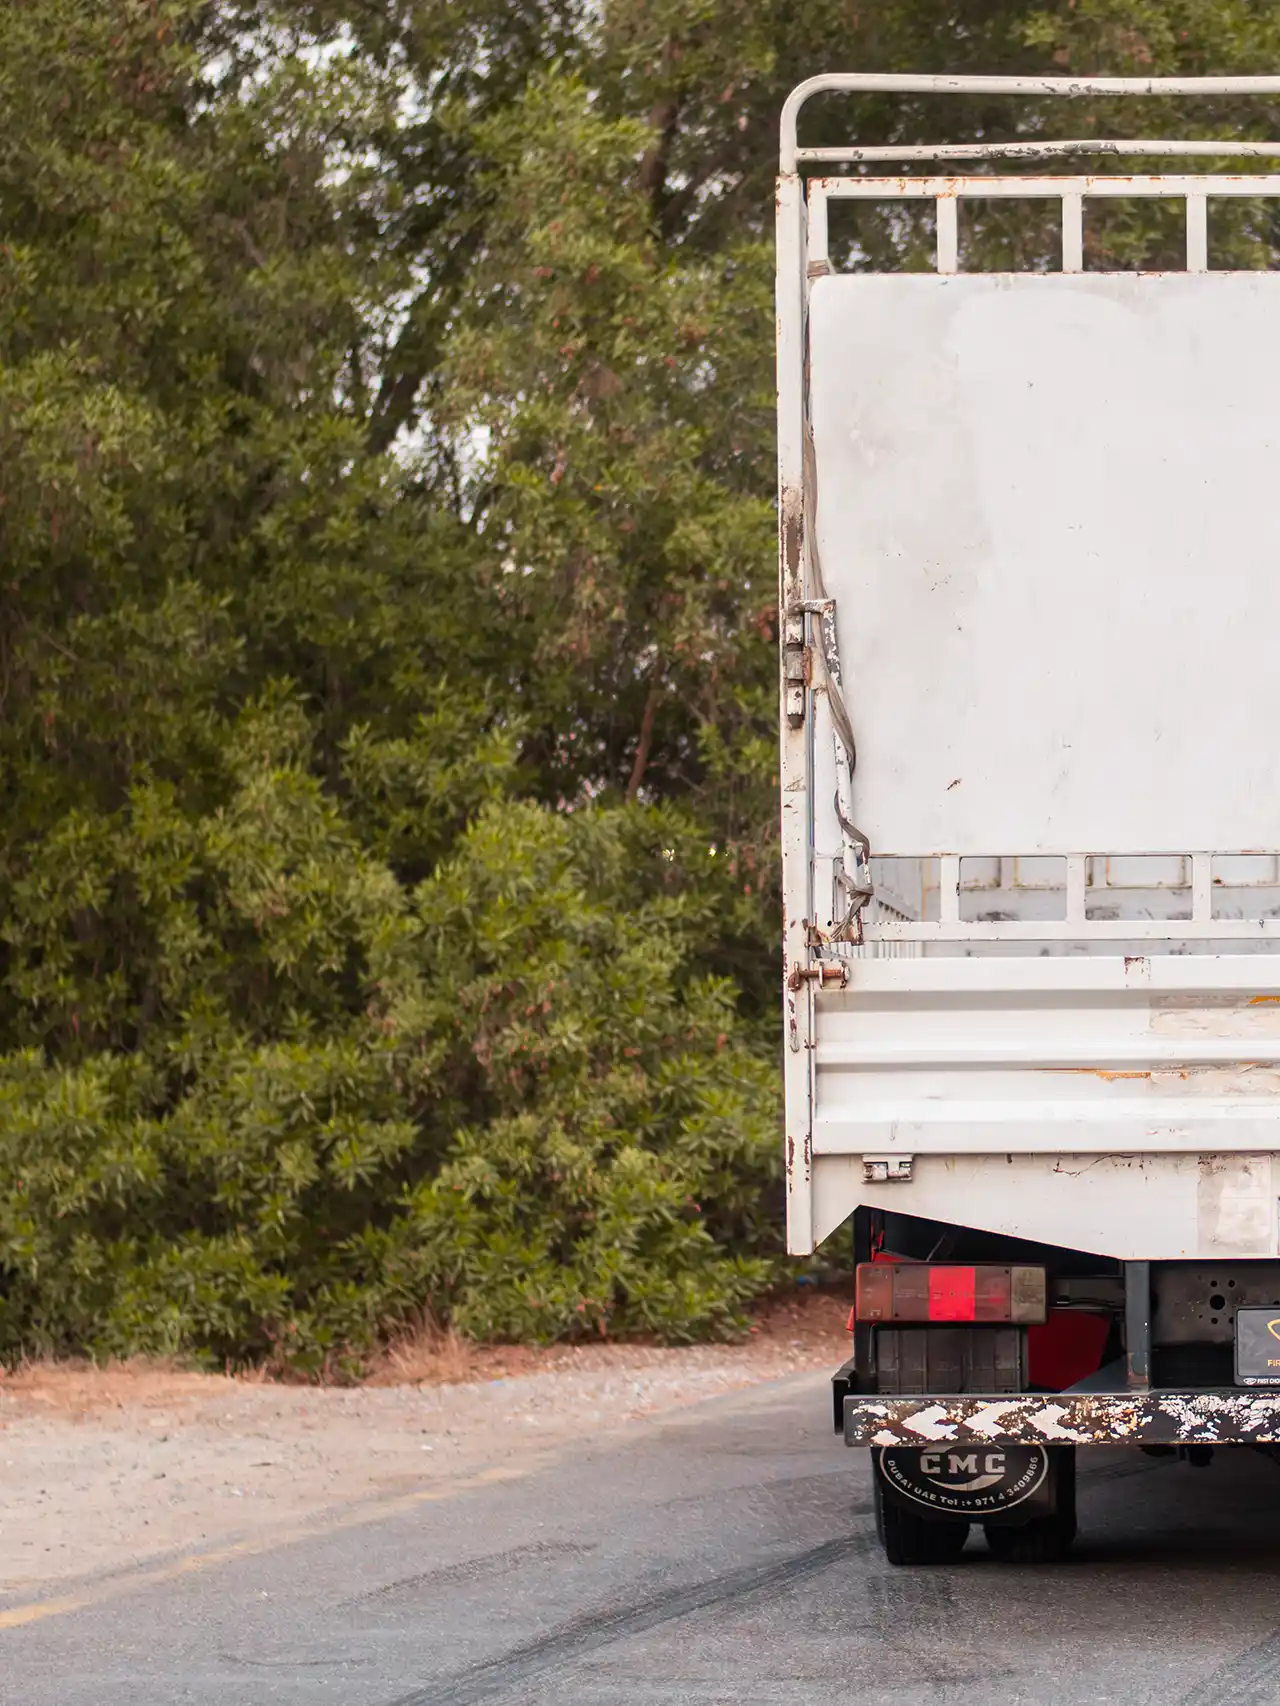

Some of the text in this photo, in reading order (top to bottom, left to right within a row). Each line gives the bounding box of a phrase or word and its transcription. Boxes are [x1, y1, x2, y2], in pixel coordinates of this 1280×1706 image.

[887, 1460, 912, 1489] DUBAI
[914, 1486, 937, 1501] UAE
[939, 1496, 958, 1506] Tel
[975, 1496, 996, 1506] 971
[999, 1492, 1005, 1500] 4
[1006, 1456, 1039, 1497] 3409866
[919, 1454, 1006, 1474] CMC
